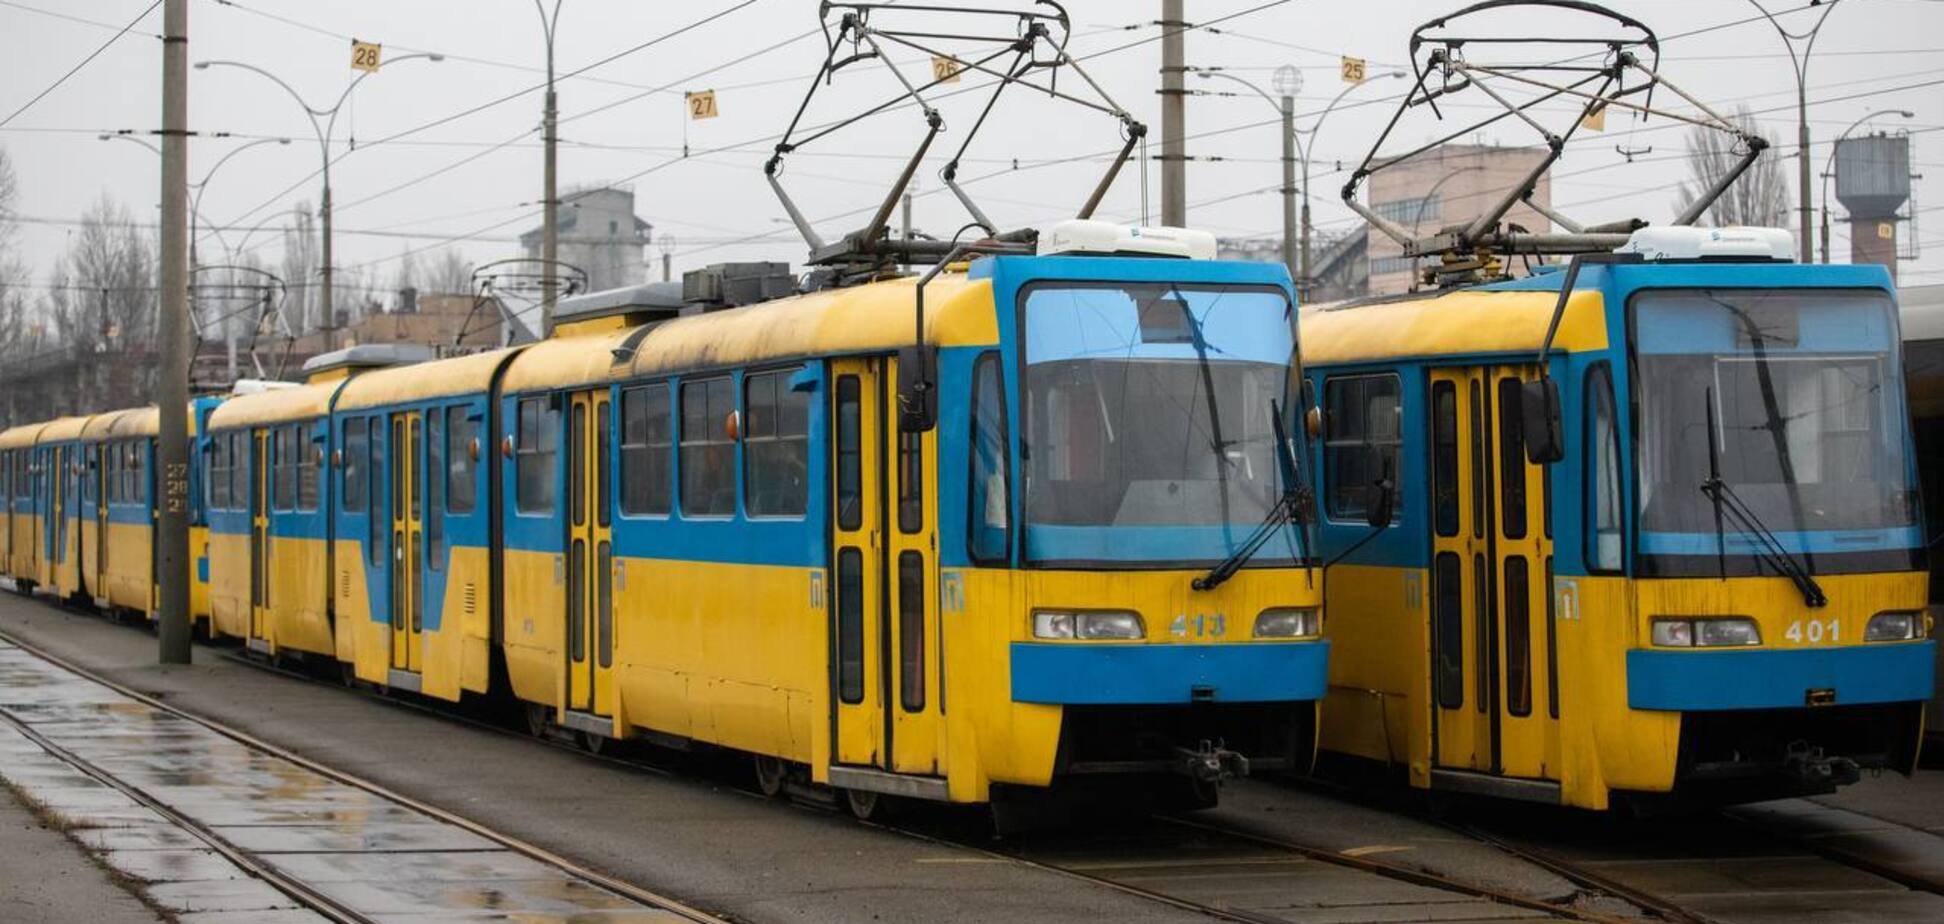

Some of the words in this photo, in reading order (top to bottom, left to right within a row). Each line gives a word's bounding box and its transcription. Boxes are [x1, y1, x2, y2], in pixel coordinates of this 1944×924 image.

[355, 47, 377, 66] 28
[936, 61, 957, 80] 26
[1344, 62, 1363, 79] 25
[692, 96, 712, 115] 27
[167, 463, 187, 478] 27
[1168, 614, 1225, 637] 413
[1785, 619, 1839, 642] 401
